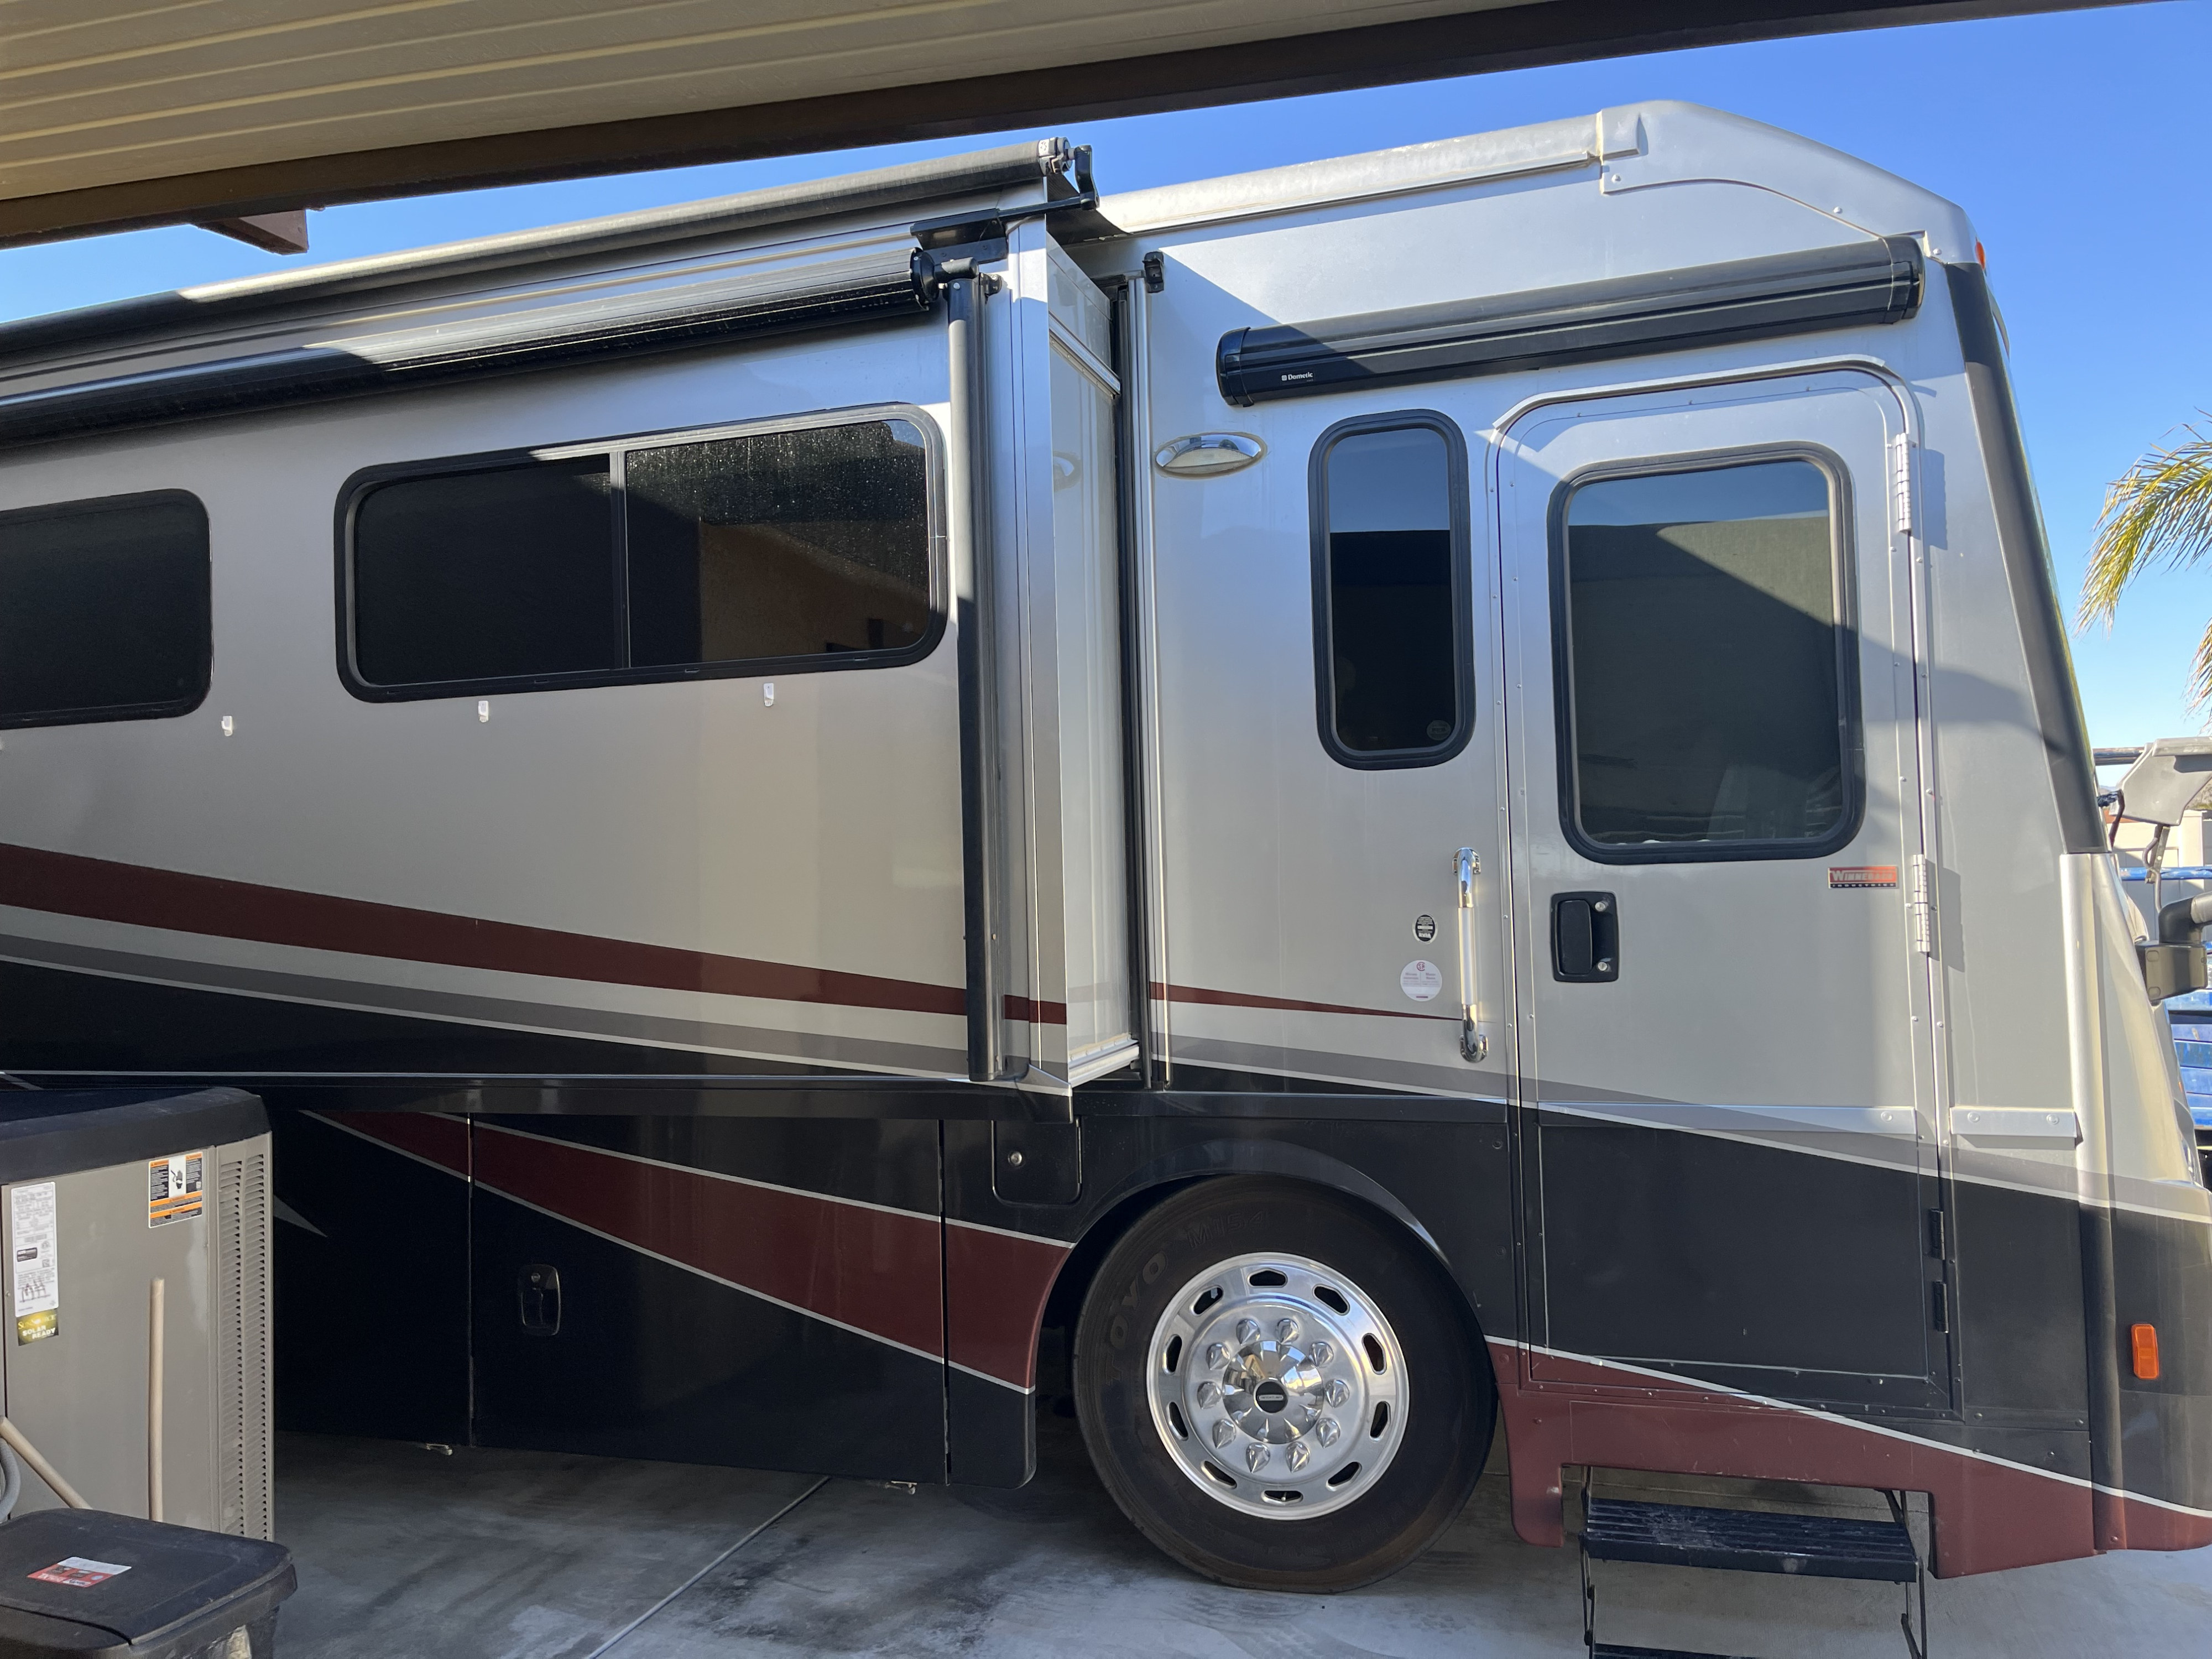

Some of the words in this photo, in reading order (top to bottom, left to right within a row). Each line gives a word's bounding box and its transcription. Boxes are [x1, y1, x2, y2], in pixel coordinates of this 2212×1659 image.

[1287, 372, 1313, 380] Dometic
[1186, 1212, 1265, 1249] M154
[1108, 1251, 1167, 1385] TOYO
[22, 1325, 46, 1337] SOLAR
[32, 1327, 56, 1339] READY
